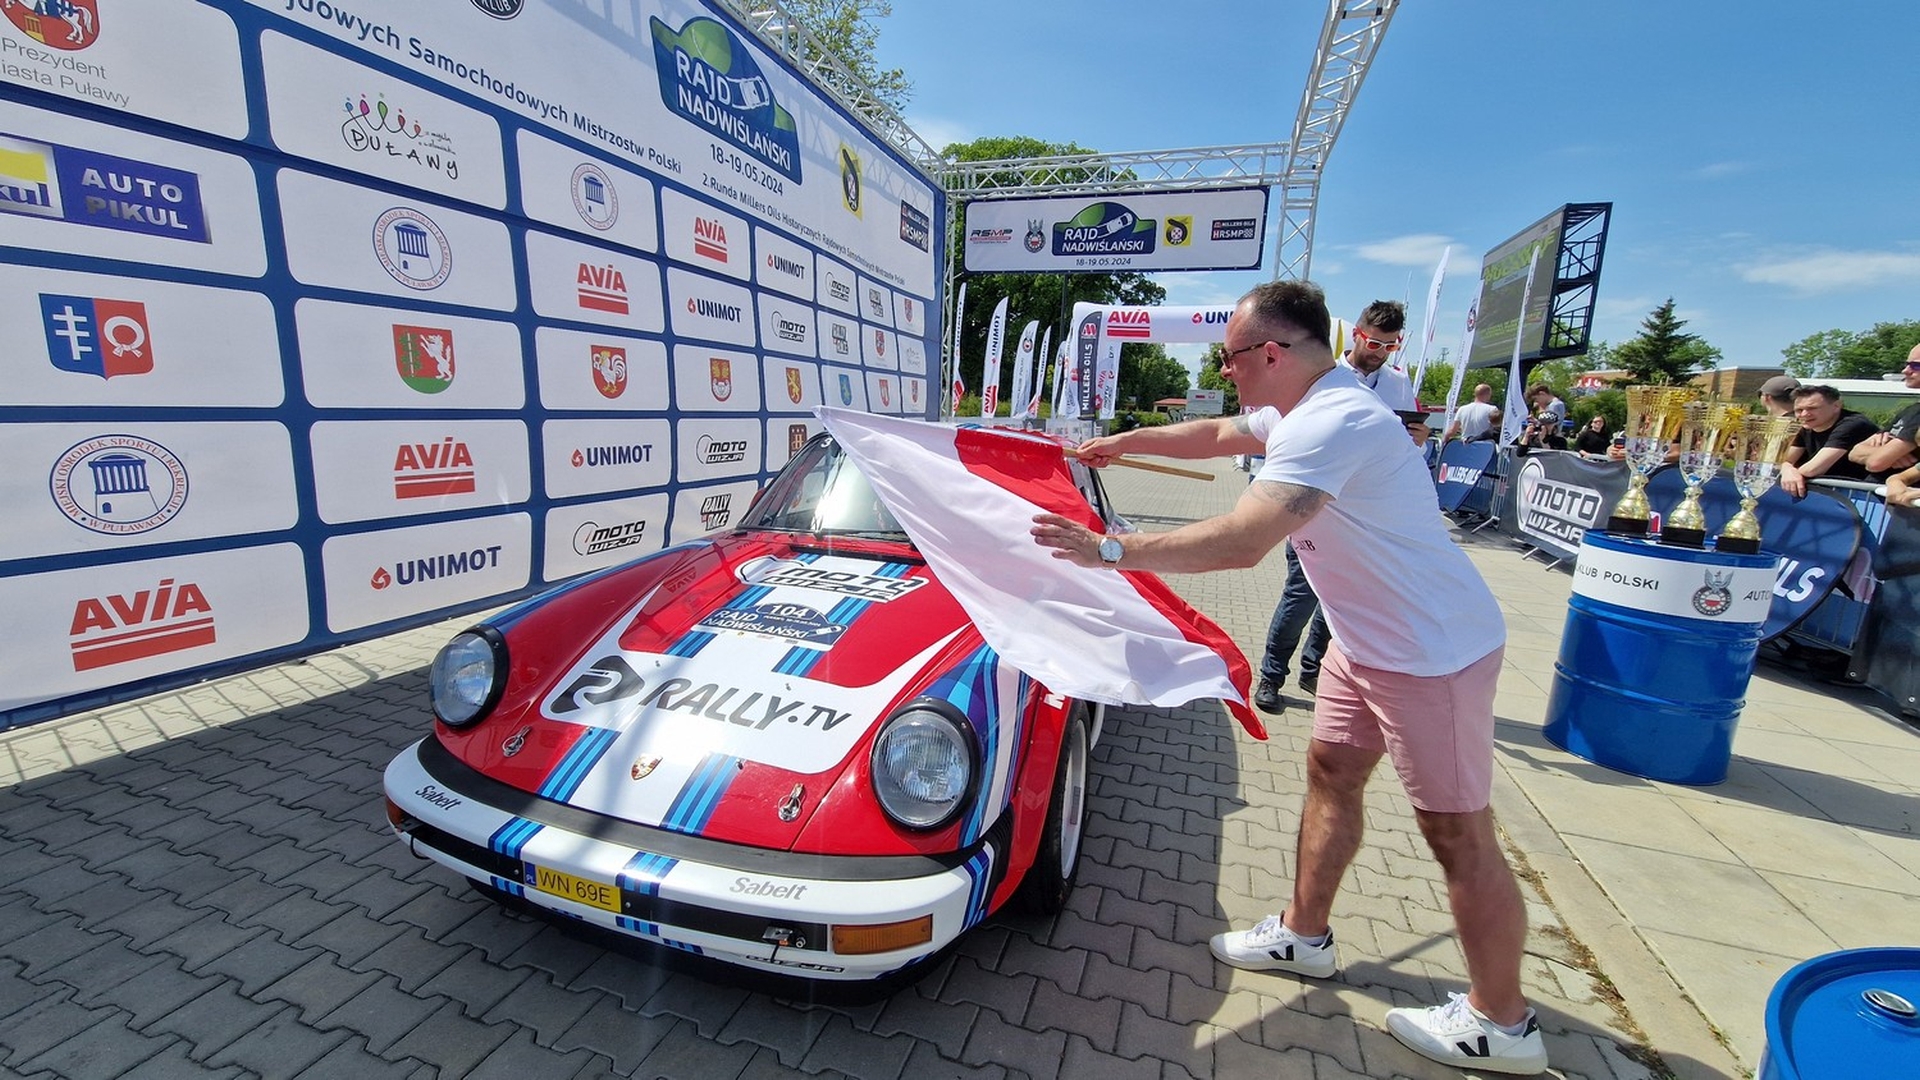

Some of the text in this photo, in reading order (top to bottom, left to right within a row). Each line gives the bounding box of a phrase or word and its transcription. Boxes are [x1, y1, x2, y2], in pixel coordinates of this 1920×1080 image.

[1, 37, 107, 80] Prezydent
[676, 50, 731, 106] RAJD
[60, 74, 130, 108] Puławy
[408, 37, 568, 124] Samochodowych
[573, 112, 645, 158] Mistrzostw
[649, 147, 682, 174] Polski
[679, 83, 791, 172] NADWIŚLAŃSKI
[350, 128, 458, 180] PUŁAWY
[710, 143, 783, 196] 18-19.05.2024
[82, 167, 184, 203] AUTO
[86, 196, 188, 230] PIKUL
[739, 191, 766, 214] Millers
[767, 204, 781, 221] Oils
[694, 217, 727, 244] AVIA
[971, 229, 1013, 237] RSMP
[1064, 228, 1098, 241] RAJD
[1213, 229, 1244, 239] HRSMP
[1062, 238, 1144, 252] NADWIŚLAŃSKI
[774, 256, 805, 279] UNIMOT
[1076, 258, 1132, 266] 18-19.05.2024
[577, 264, 627, 293] AVIA
[697, 299, 741, 323] UNIMOT
[1107, 309, 1151, 324] AVIA
[780, 319, 806, 334] MOTO
[991, 315, 1001, 356] UNIMOT
[1084, 343, 1093, 366] OILS
[1082, 369, 1090, 411] MILLERS
[110, 438, 163, 458] SPORTU
[394, 436, 473, 471] AVIA
[587, 445, 652, 467] UNIMOT
[706, 453, 745, 464] WIZJA
[709, 441, 747, 453] MOTO
[1446, 465, 1468, 483] MILLERS
[702, 494, 731, 513] RALLY
[1531, 482, 1601, 521] MOTO
[591, 520, 646, 541] MOTO
[706, 511, 729, 531] RACE
[1527, 511, 1583, 548] WIZJA
[587, 534, 643, 556] WIZJA
[396, 545, 502, 585] UNIMOT
[763, 576, 900, 601] WIZJA
[779, 567, 924, 593] MOTO
[1604, 570, 1659, 590] POLSKI
[69, 578, 213, 636] AVIA
[715, 610, 758, 621] RAJD
[771, 605, 810, 618] 104
[703, 618, 808, 639] NADWIŚLAŃSKI
[415, 785, 461, 811] Sabelt
[526, 874, 535, 884] PL
[538, 868, 612, 906] WN 69E
[729, 876, 808, 900] Sabelt
